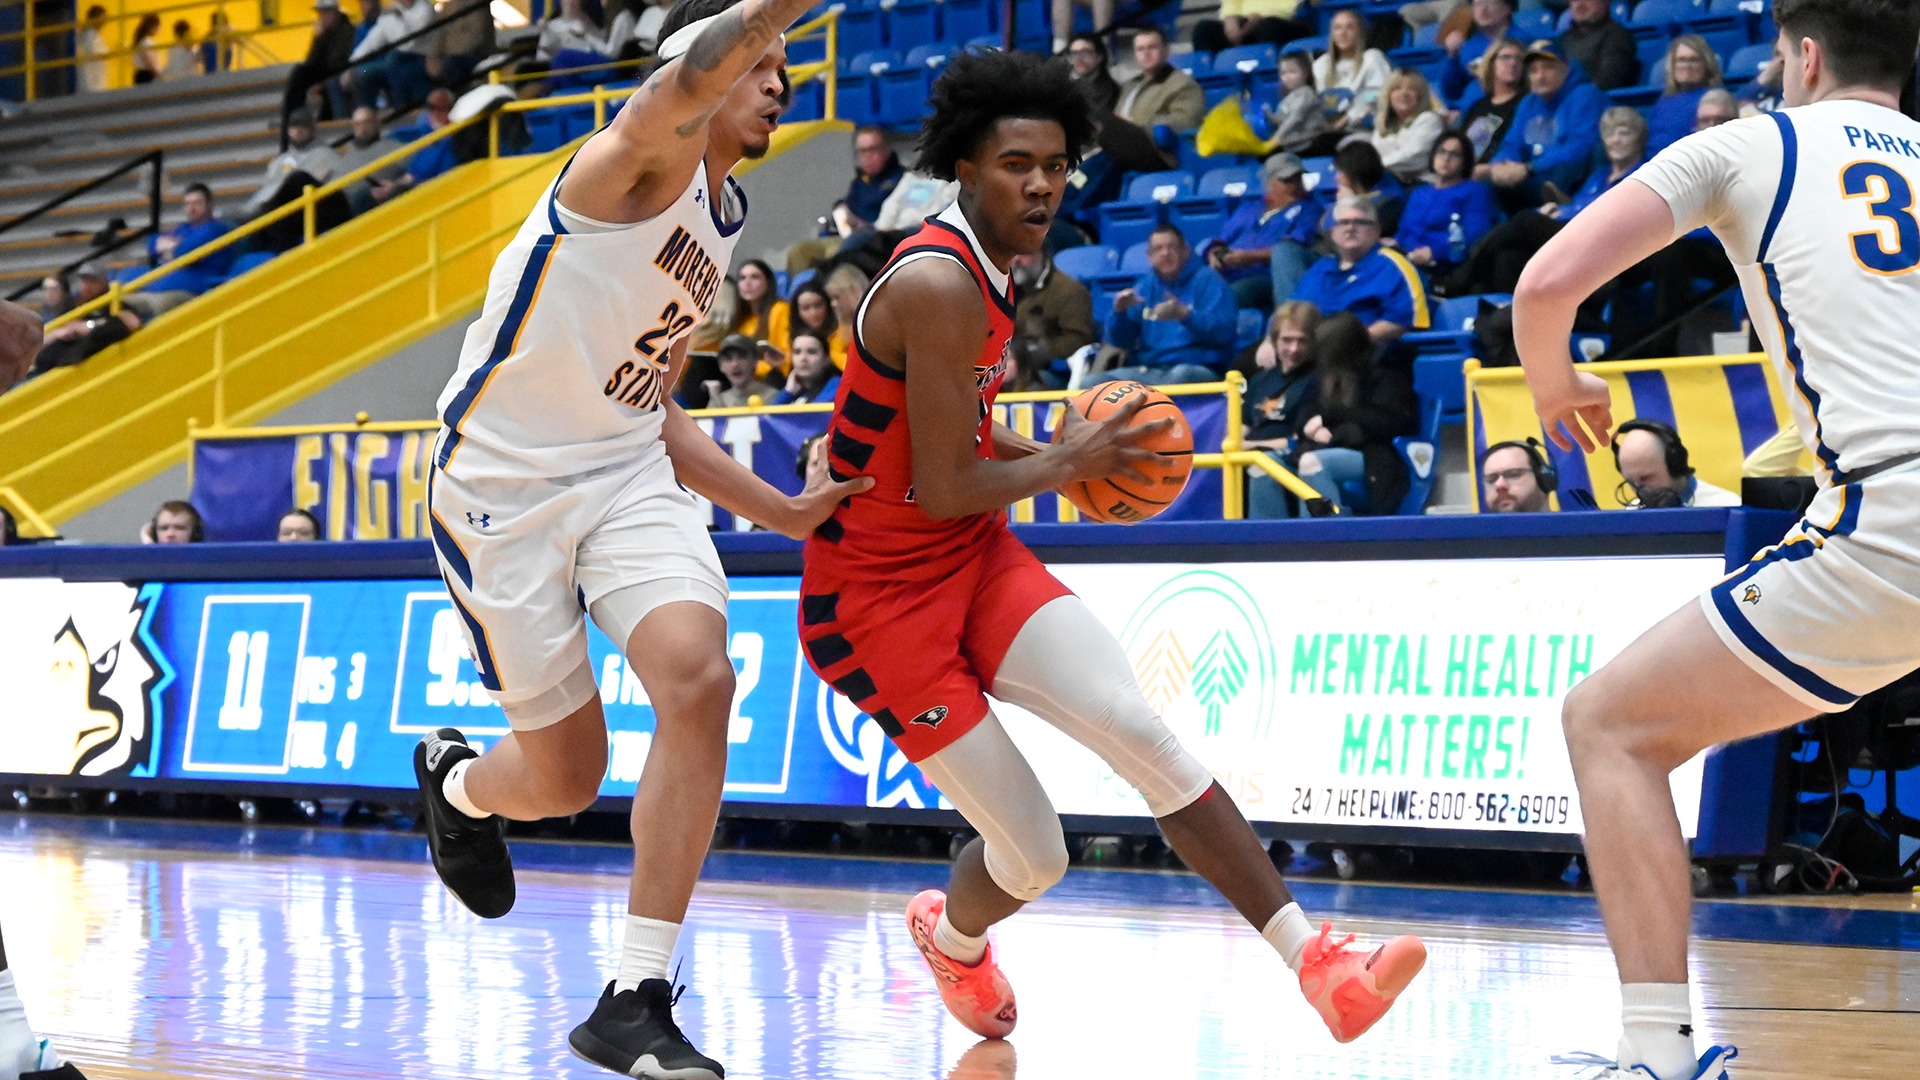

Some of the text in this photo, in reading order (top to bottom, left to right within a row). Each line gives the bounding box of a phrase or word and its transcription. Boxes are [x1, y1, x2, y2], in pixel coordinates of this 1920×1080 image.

[1837, 158, 1920, 277] 3
[633, 298, 697, 367] 22
[292, 431, 439, 542] FIGH
[217, 631, 270, 731] 11
[346, 651, 368, 700] 3
[1290, 633, 1595, 697] MENTAL HEALTH
[335, 721, 358, 770] 4
[1339, 712, 1531, 779] MATTERS!
[1337, 789, 1424, 820] HELPLINE:
[1428, 791, 1570, 824] 800-562-8909
